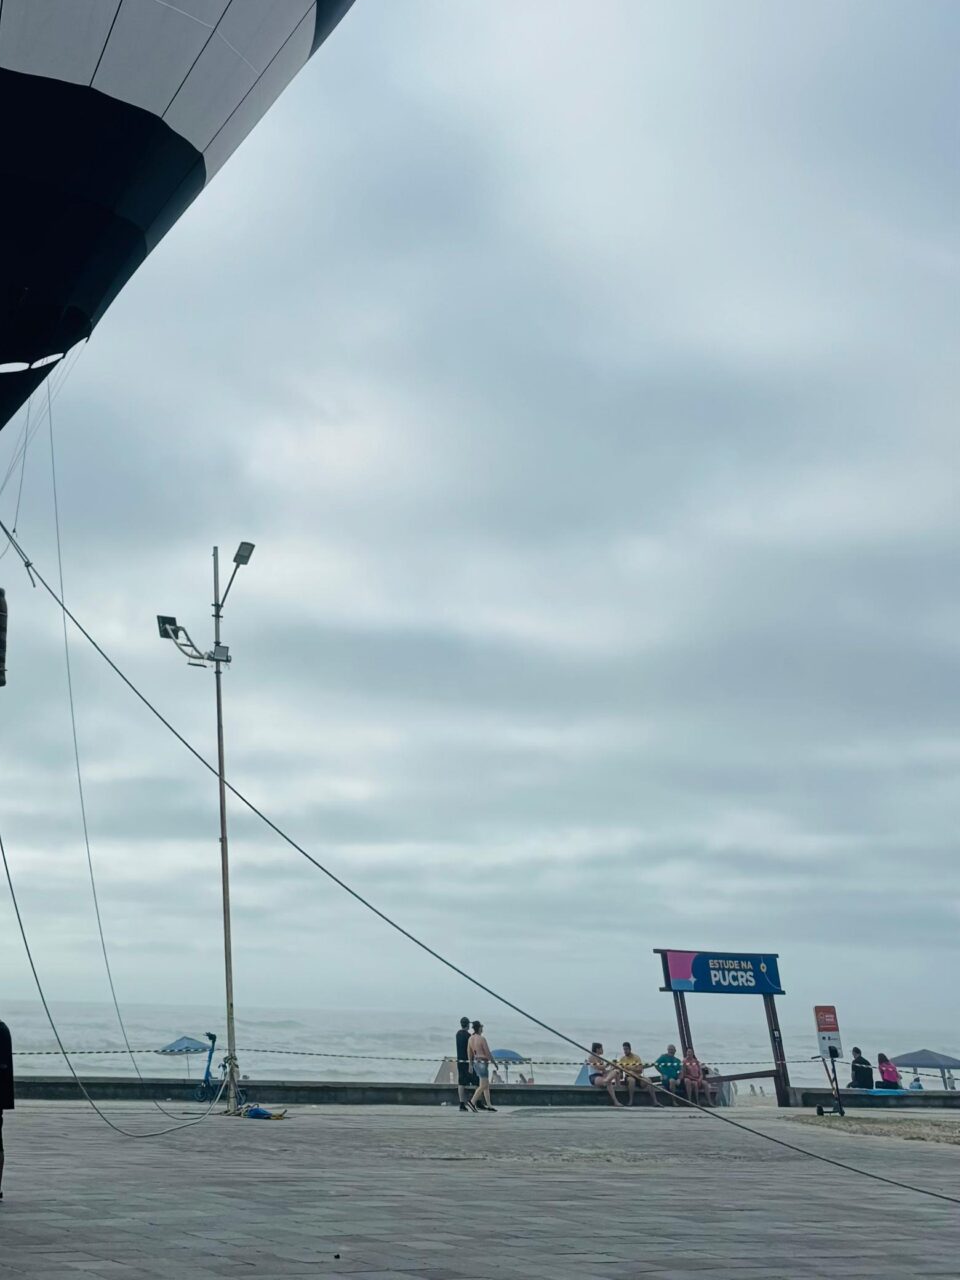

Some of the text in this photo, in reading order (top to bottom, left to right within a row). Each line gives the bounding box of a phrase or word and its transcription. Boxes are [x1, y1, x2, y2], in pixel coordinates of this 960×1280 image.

[708, 959, 753, 970] ESTUDE NA
[710, 970, 756, 987] PUCRS
